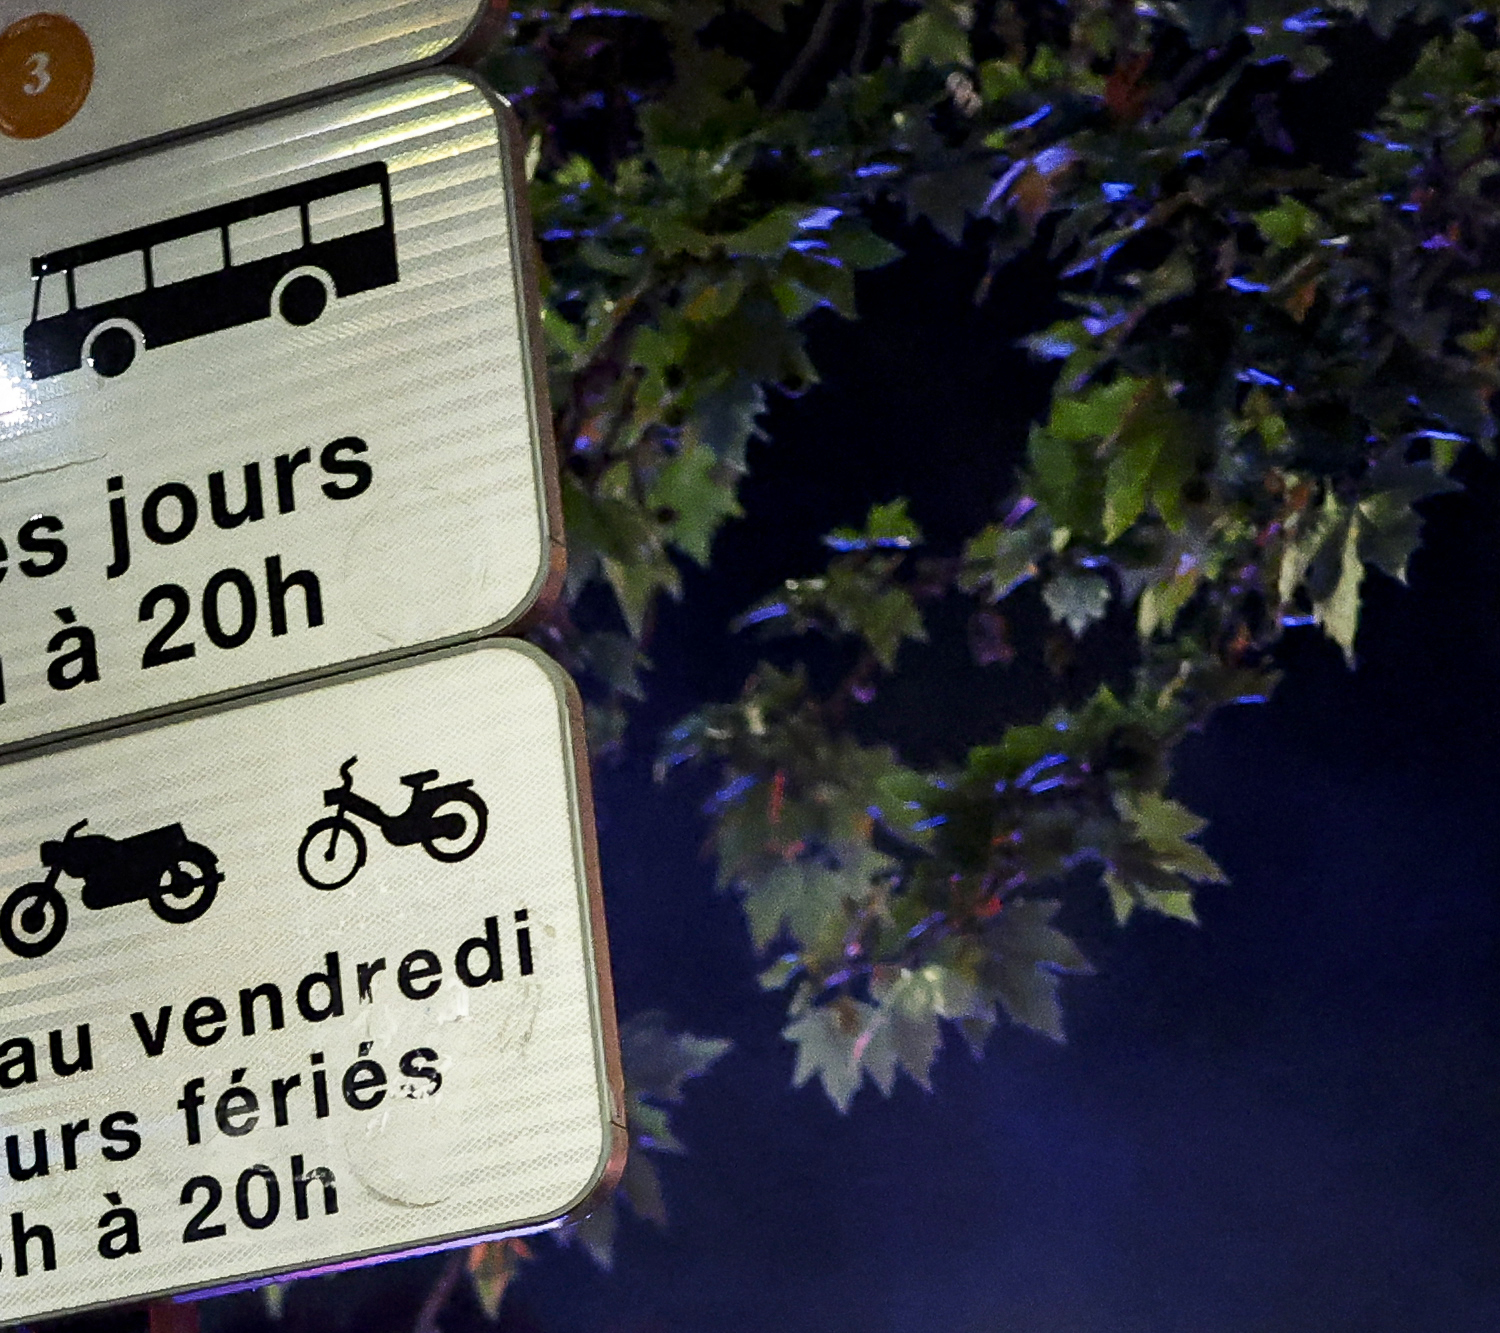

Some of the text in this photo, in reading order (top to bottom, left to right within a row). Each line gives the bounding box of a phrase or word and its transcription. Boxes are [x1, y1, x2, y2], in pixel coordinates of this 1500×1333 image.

[22, 52, 51, 97] 3
[107, 437, 372, 578] jours
[47, 607, 99, 690] à
[139, 556, 323, 668] 20h
[131, 910, 532, 1059] vendredi
[178, 1043, 441, 1144] fériés
[98, 1192, 140, 1259] à
[180, 1155, 337, 1242] 20h
